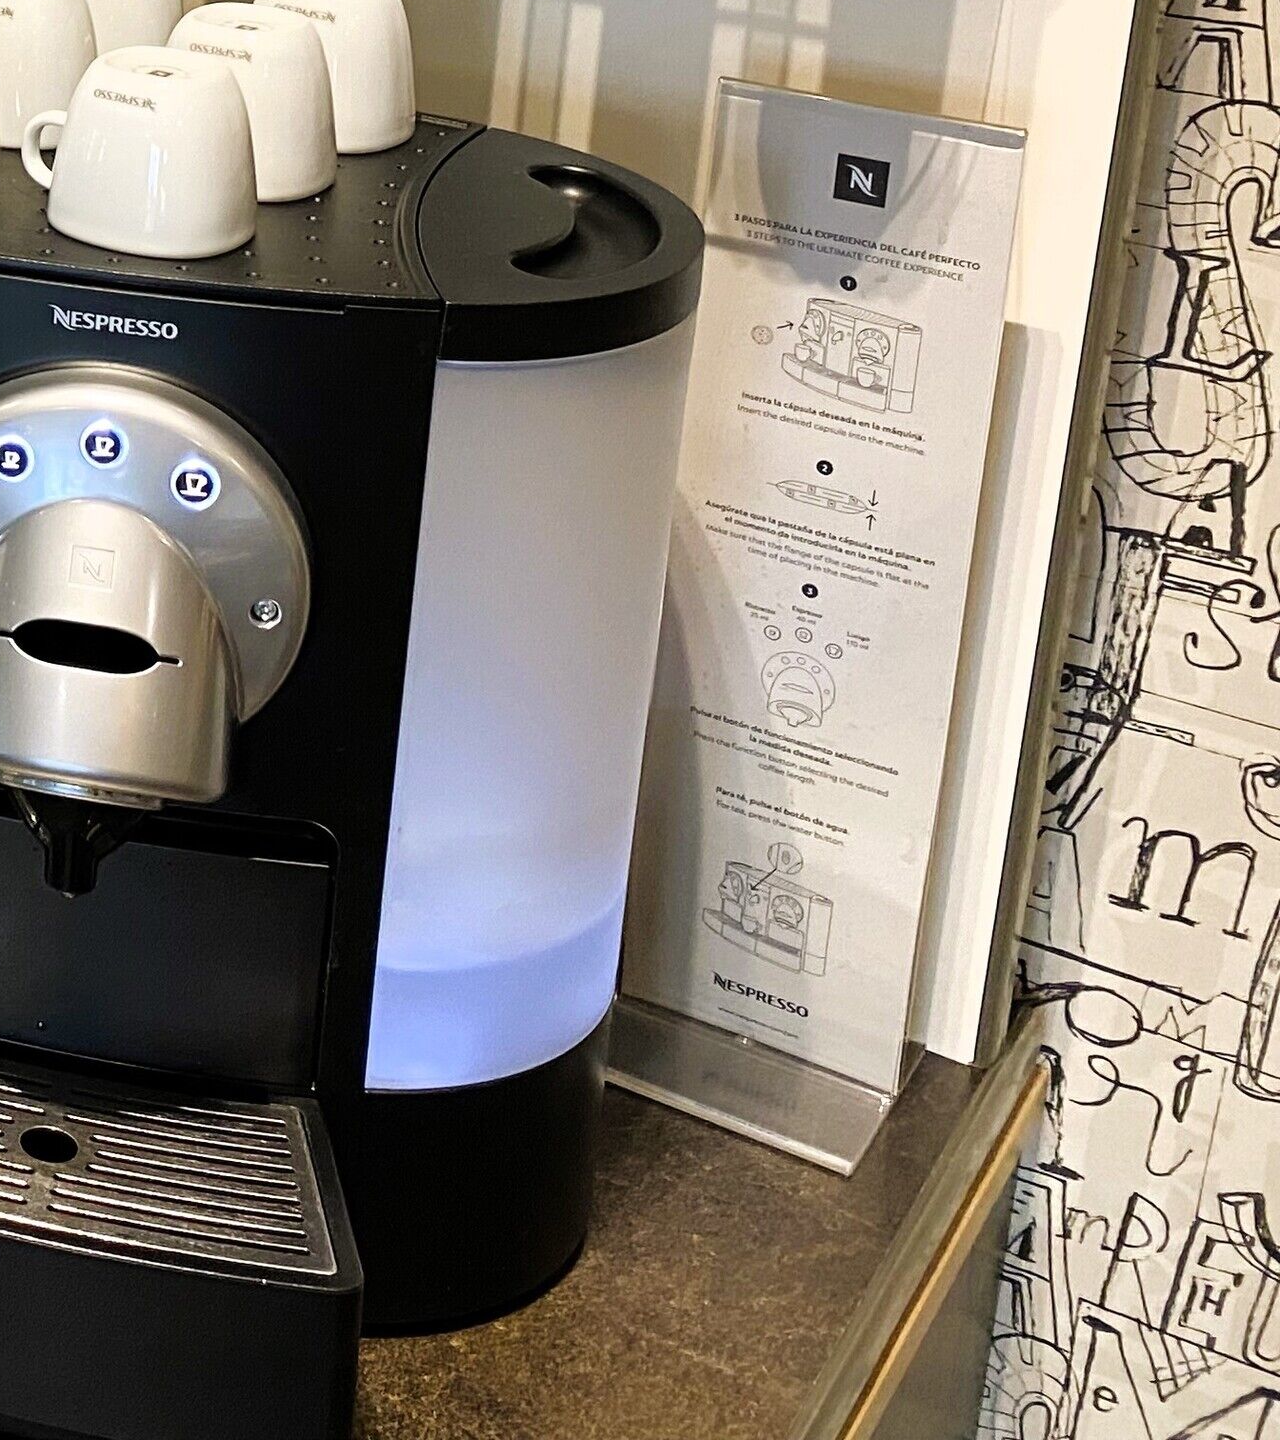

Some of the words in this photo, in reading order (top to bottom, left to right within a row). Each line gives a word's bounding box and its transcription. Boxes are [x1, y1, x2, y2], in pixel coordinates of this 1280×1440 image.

[814, 230, 878, 251] EXPERIENCIA
[880, 243, 899, 254] DEL
[928, 253, 981, 271] PERFECTO
[49, 303, 179, 341] NESPRESSO
[712, 970, 809, 1018] NESPRESSO
